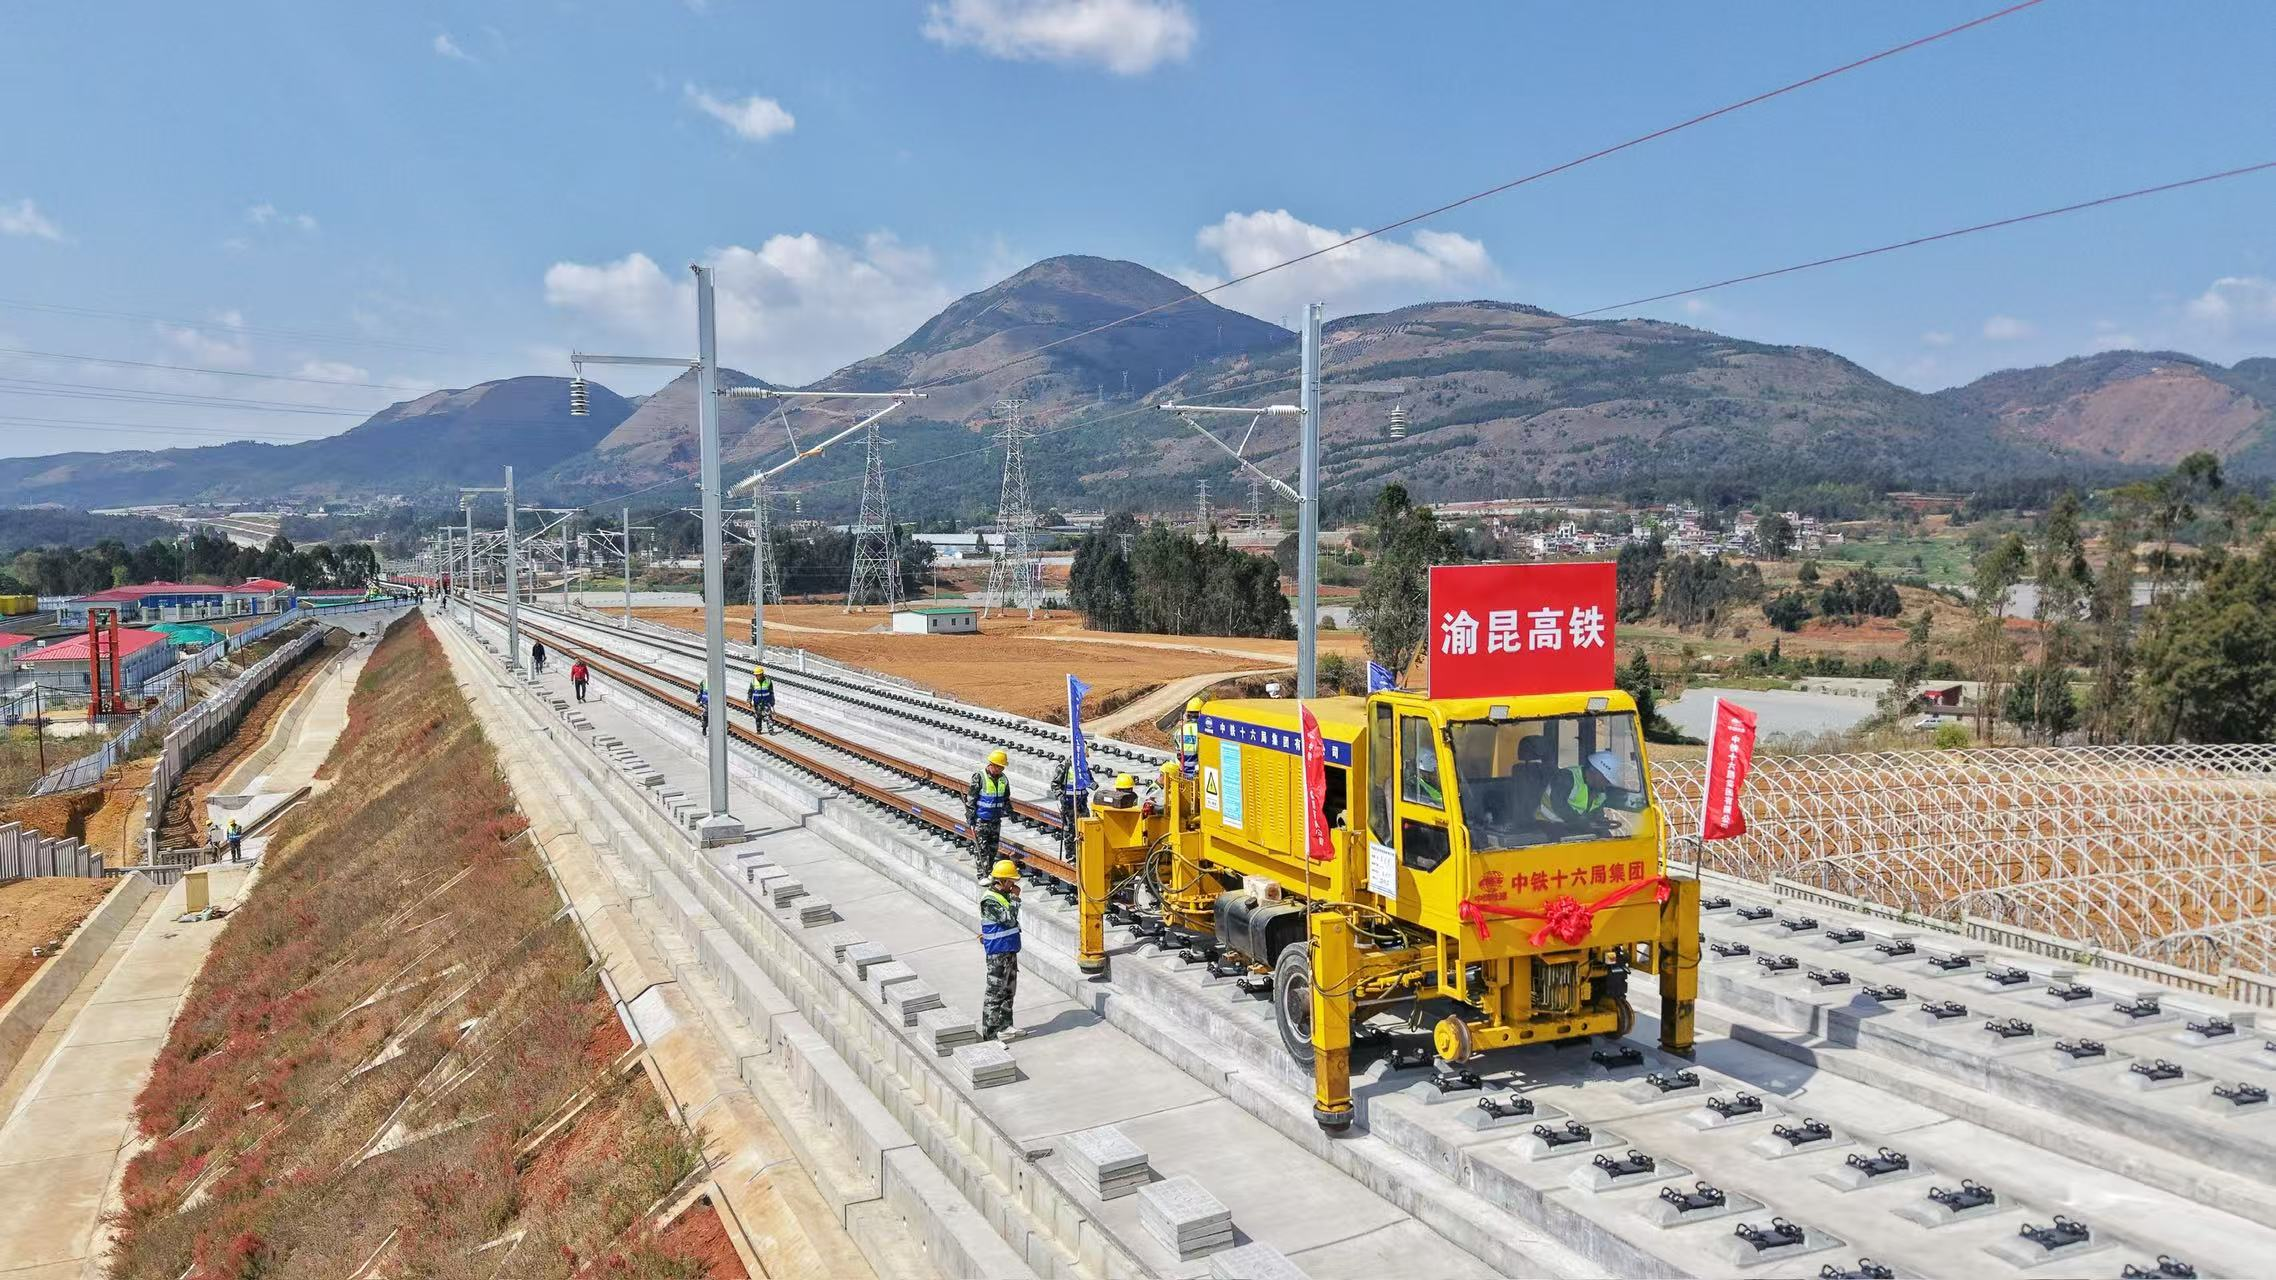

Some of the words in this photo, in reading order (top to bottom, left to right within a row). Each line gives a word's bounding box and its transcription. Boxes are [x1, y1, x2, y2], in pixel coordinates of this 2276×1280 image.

[1440, 605, 1605, 655] 渝昆高铁
[1219, 722, 1339, 760] 中铁十六局集团有司
[1511, 861, 1645, 894] 中铁十六局集团
